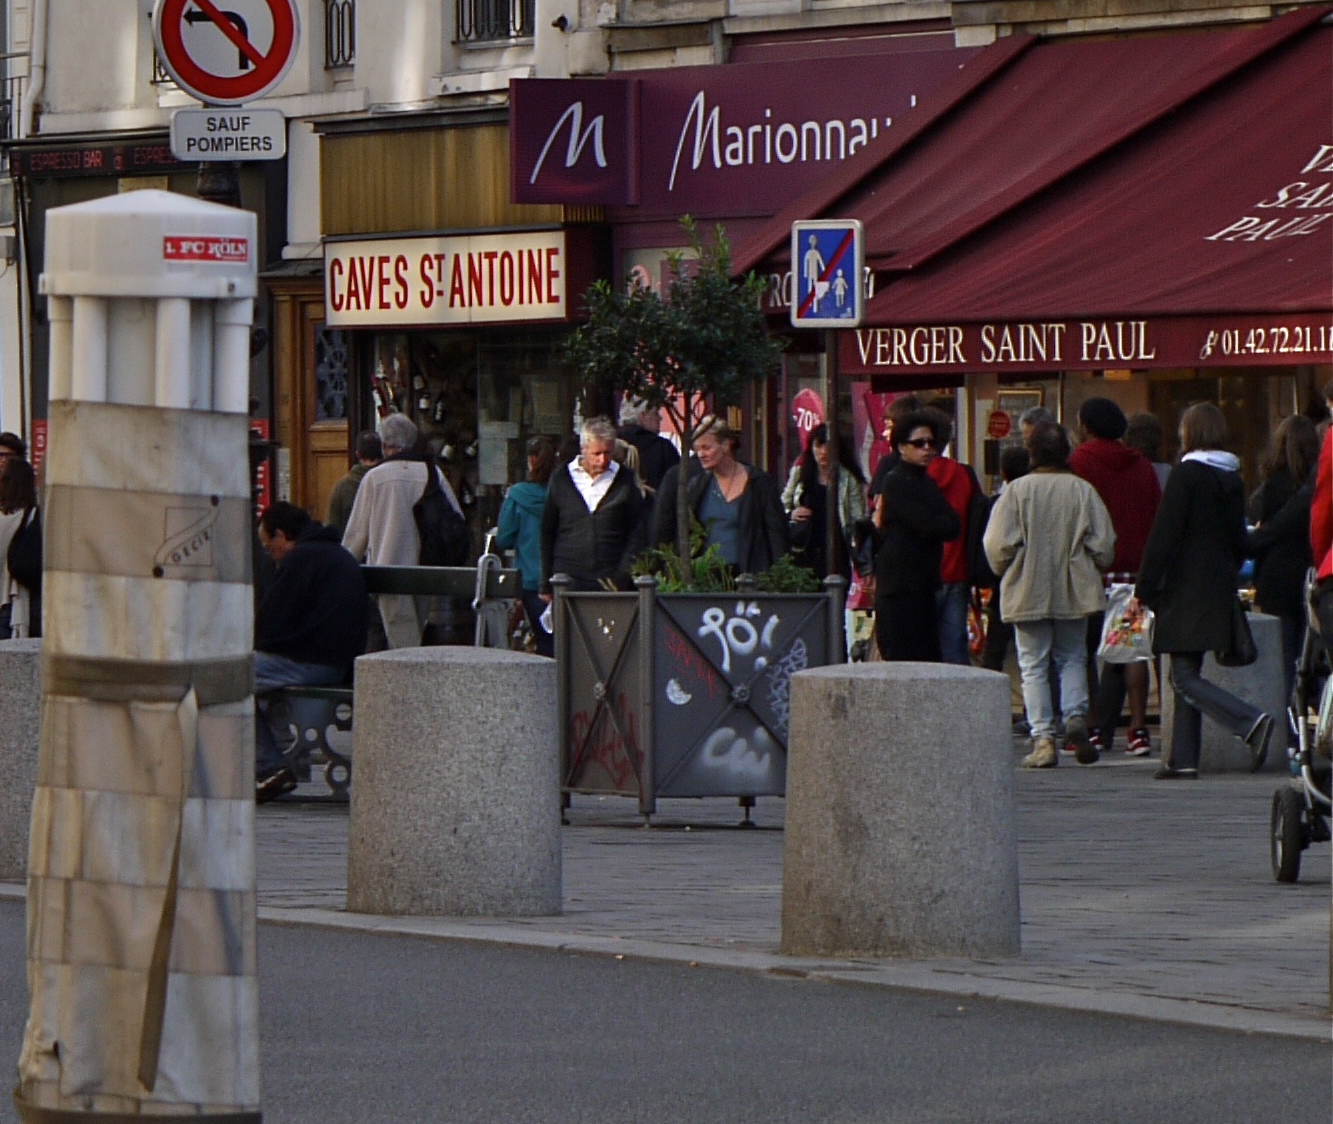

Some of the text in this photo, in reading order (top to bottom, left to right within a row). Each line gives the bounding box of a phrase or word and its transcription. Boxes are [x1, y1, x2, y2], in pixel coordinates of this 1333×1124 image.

[206, 116, 251, 132] SAUF
[186, 136, 273, 152] POMPIERS
[529, 101, 607, 184] M
[668, 90, 916, 192] Marionna
[31, 151, 81, 171] ESPRESSO
[83, 150, 103, 168] BAR
[179, 241, 205, 254] FC
[207, 238, 247, 258] KÖLN
[329, 254, 409, 312] CAVES
[449, 247, 561, 308] ANTOINE
[855, 326, 967, 366] VERGER
[981, 323, 1067, 363] SAINT
[1080, 321, 1157, 362] PAUL
